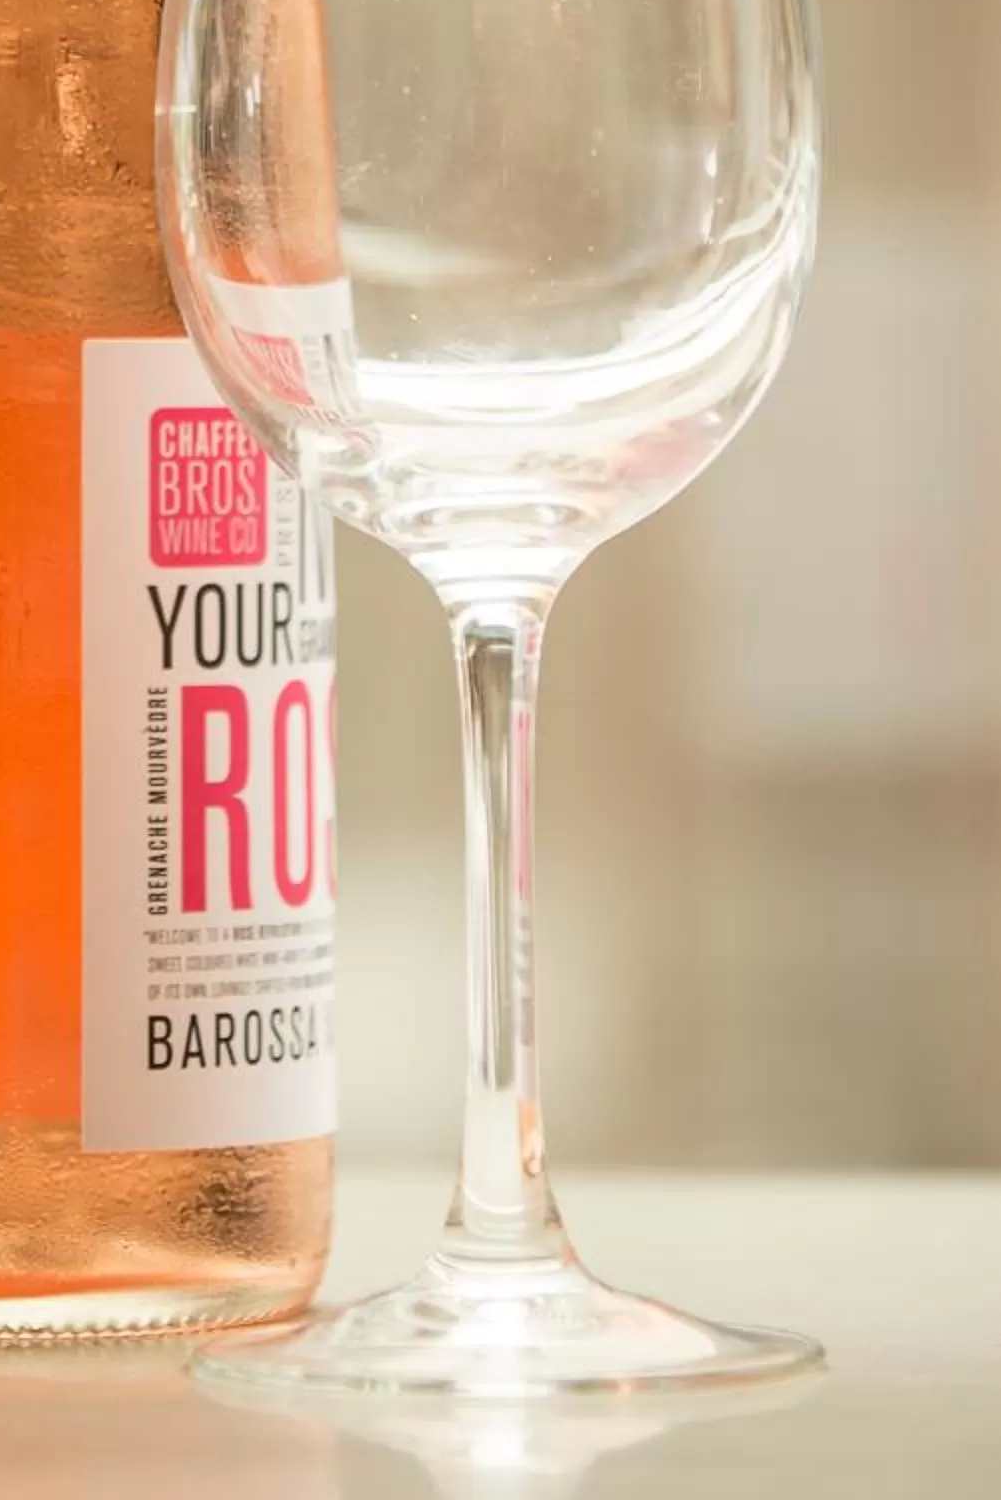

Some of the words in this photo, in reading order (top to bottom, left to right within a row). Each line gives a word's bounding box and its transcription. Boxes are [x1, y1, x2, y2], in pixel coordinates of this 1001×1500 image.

[158, 517, 223, 556] WINE
[147, 581, 295, 670] YOUR
[143, 686, 168, 804] MOURVÈDRE
[148, 815, 168, 916] GRENACHE
